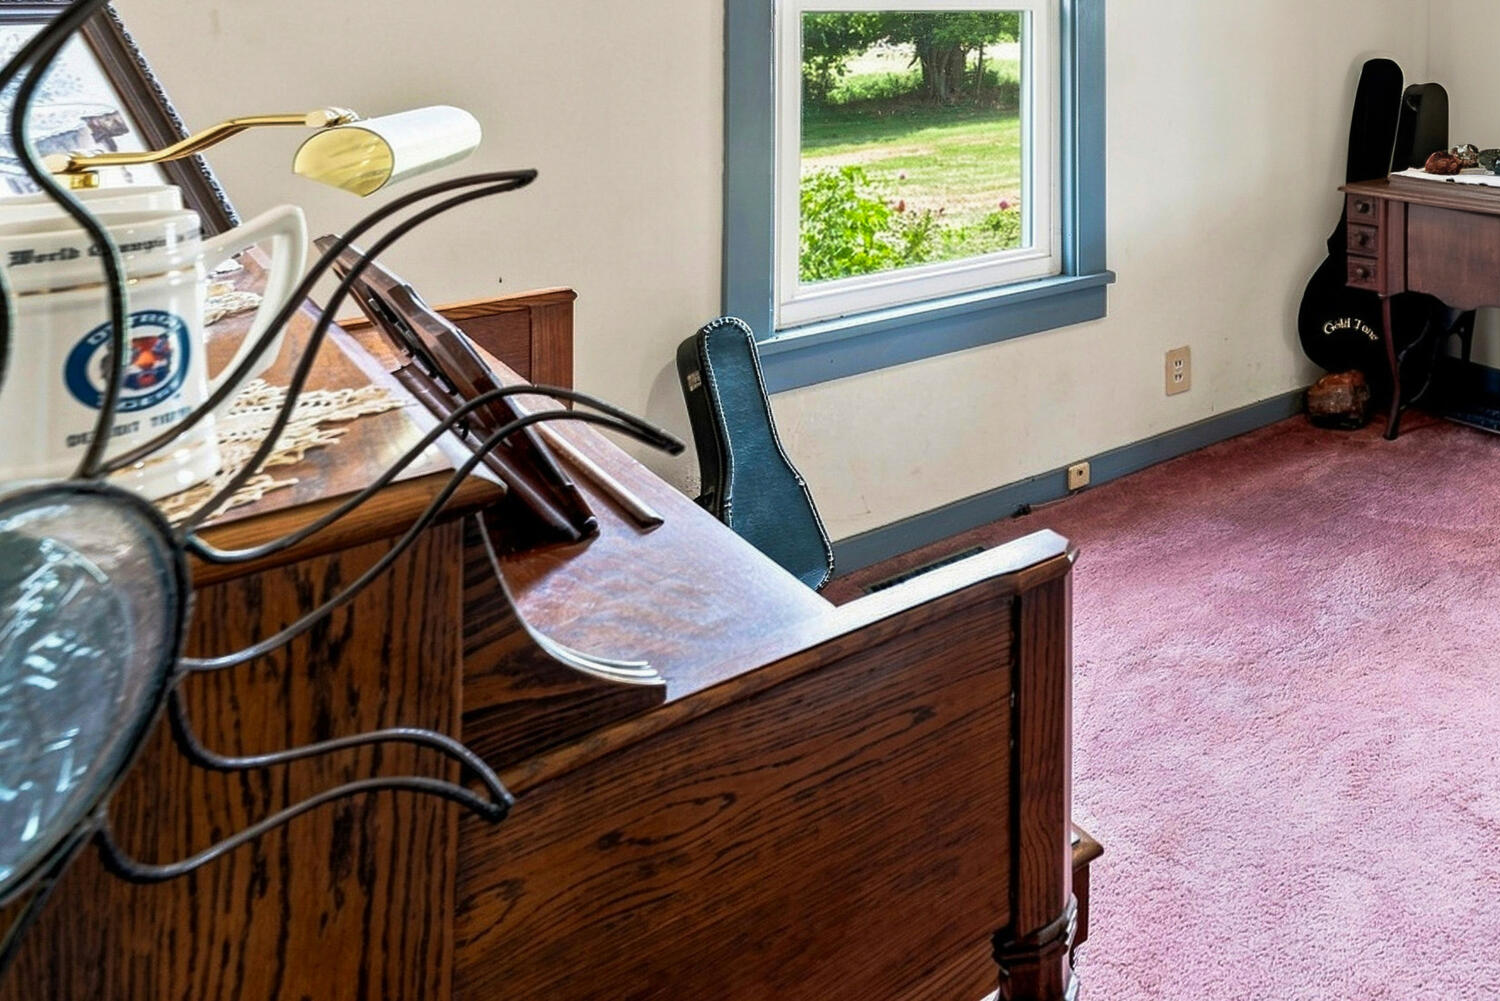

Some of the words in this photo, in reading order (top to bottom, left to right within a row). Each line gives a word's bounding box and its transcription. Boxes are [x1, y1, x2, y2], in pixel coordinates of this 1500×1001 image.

[8, 247, 80, 267] World
[1323, 317, 1351, 335] Gold
[1353, 318, 1379, 341] Tone
